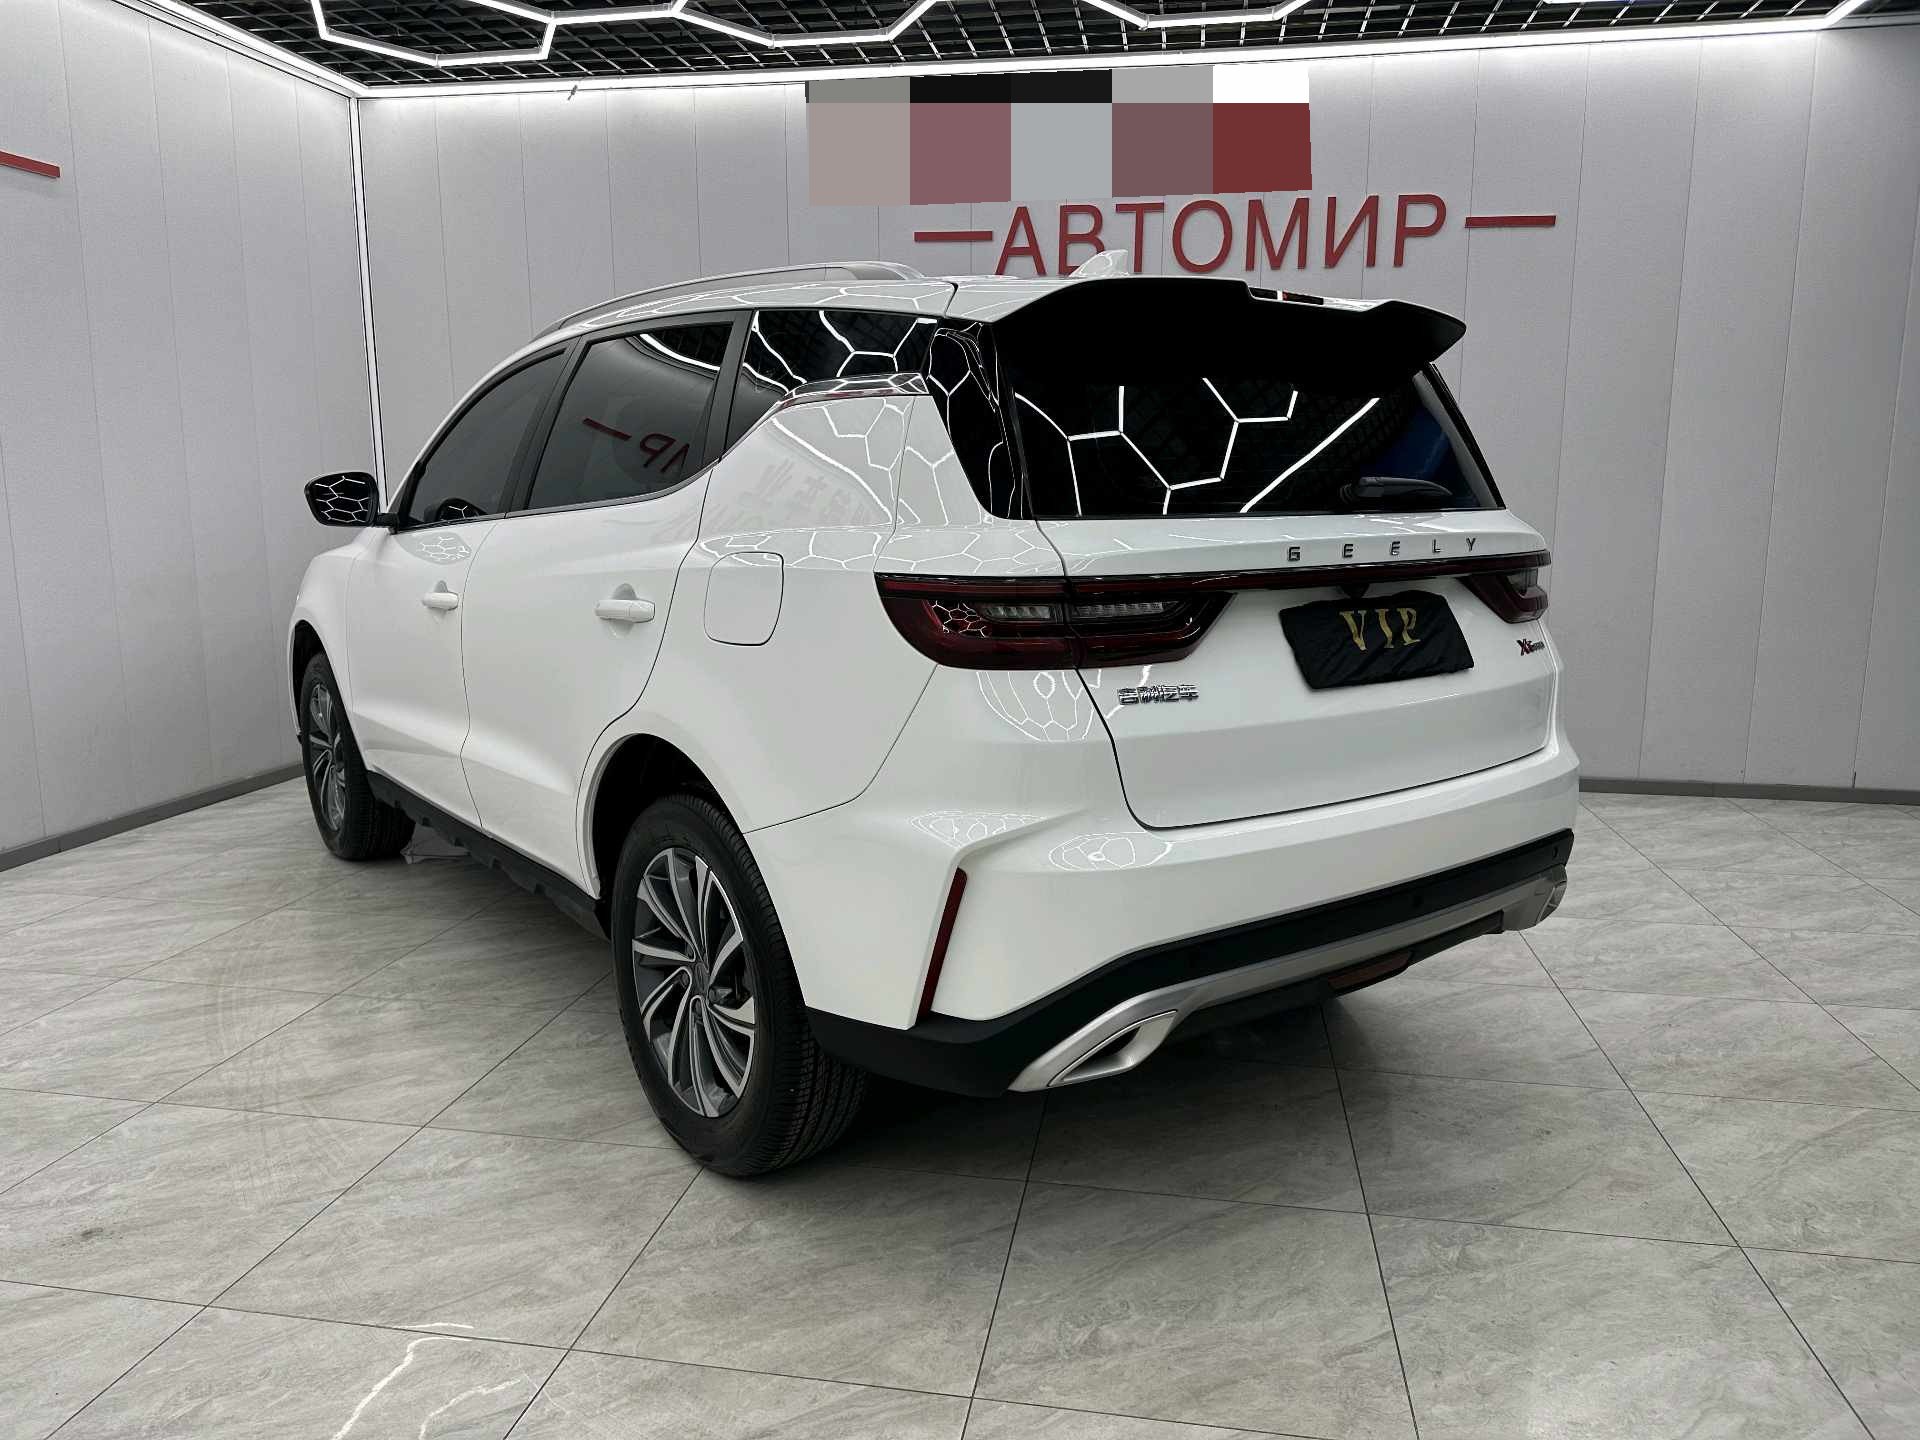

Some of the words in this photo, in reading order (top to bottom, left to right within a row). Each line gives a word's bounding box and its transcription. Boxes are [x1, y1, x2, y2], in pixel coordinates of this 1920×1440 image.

[994, 193, 1448, 277] АВТОМИР
[1287, 537, 1477, 562] GEELY
[1339, 608, 1421, 651] VIP
